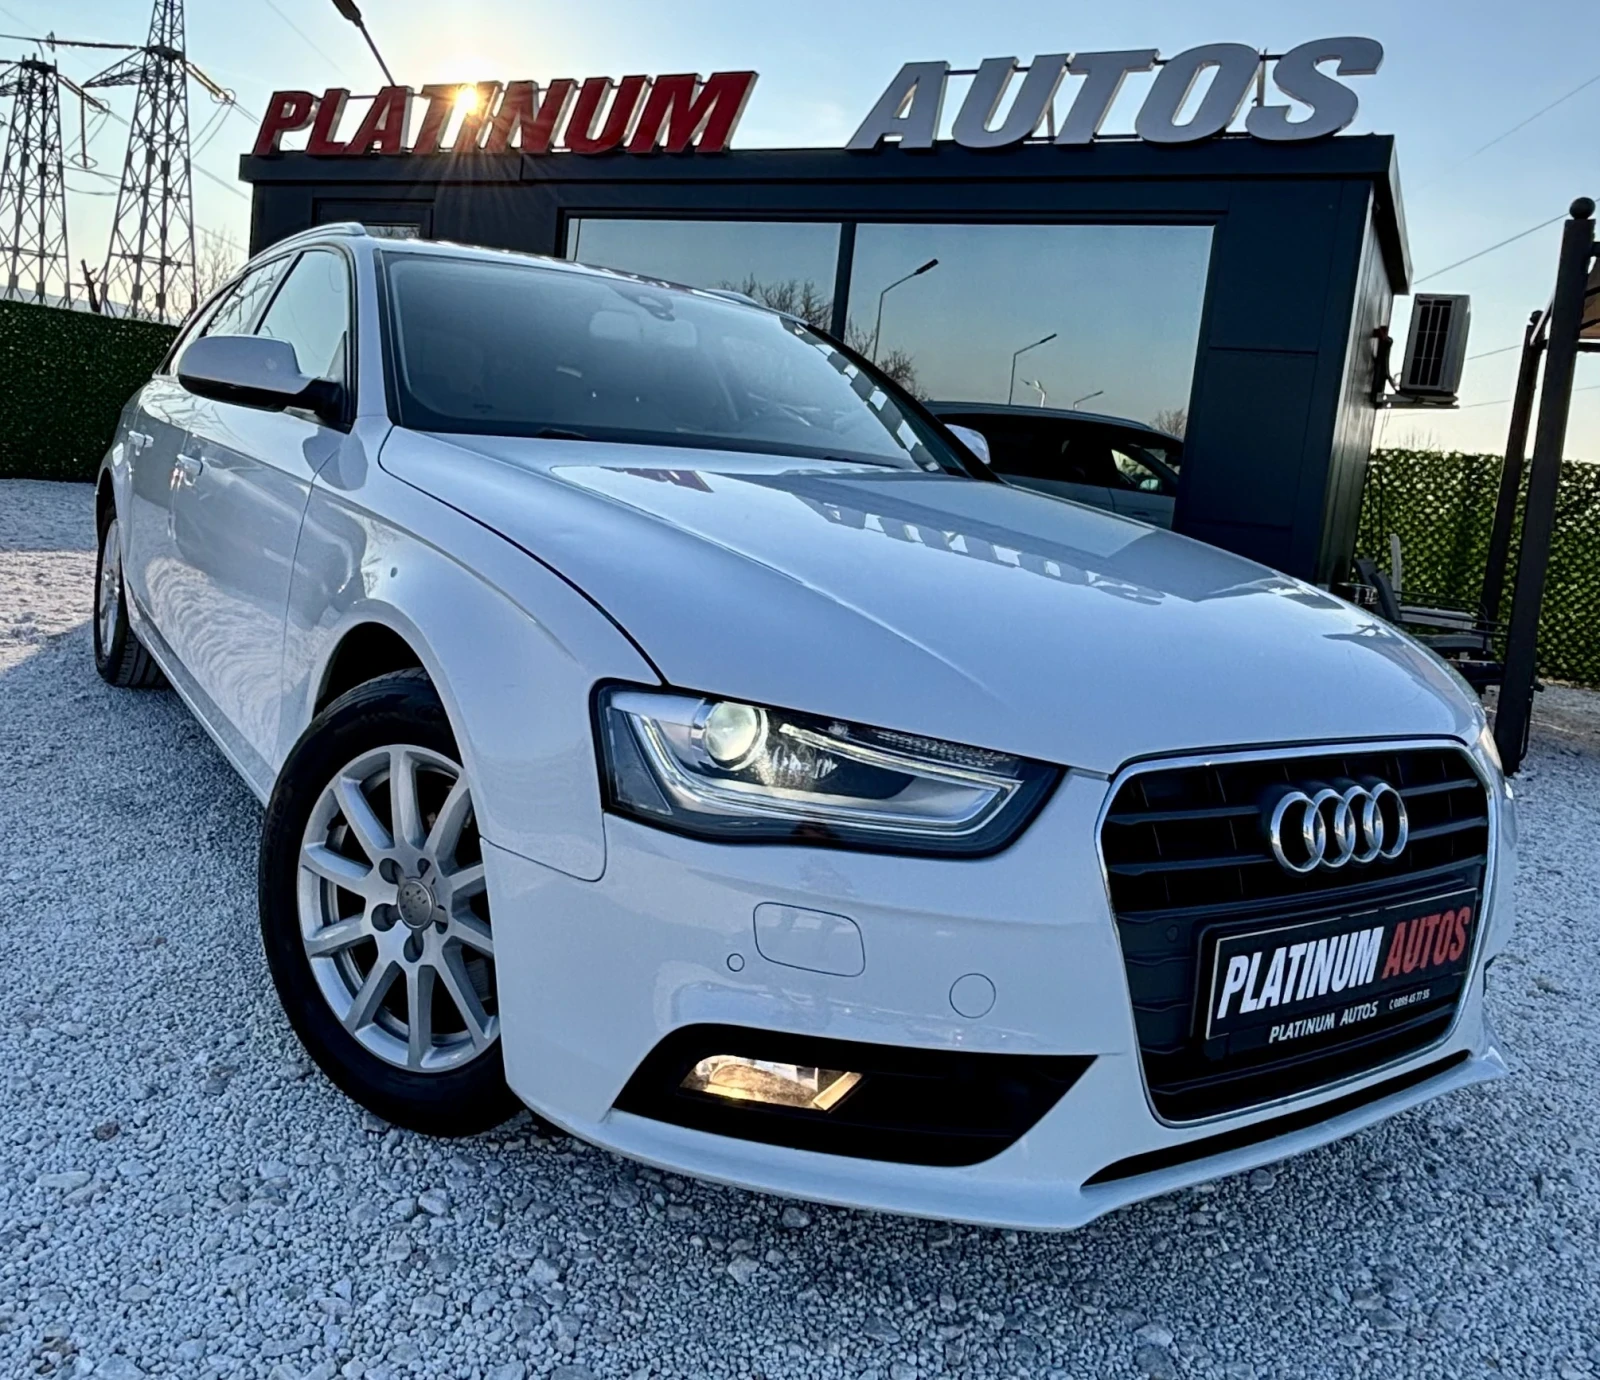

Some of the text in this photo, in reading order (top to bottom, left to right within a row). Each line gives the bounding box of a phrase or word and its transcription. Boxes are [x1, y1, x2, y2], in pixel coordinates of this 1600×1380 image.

[252, 36, 1385, 156] PLATINUM AUTOS
[1216, 906, 1471, 1020] PLATINUM AUTOS
[1268, 1013, 1336, 1044] PLATINUM
[1339, 1001, 1379, 1027] AUTOS
